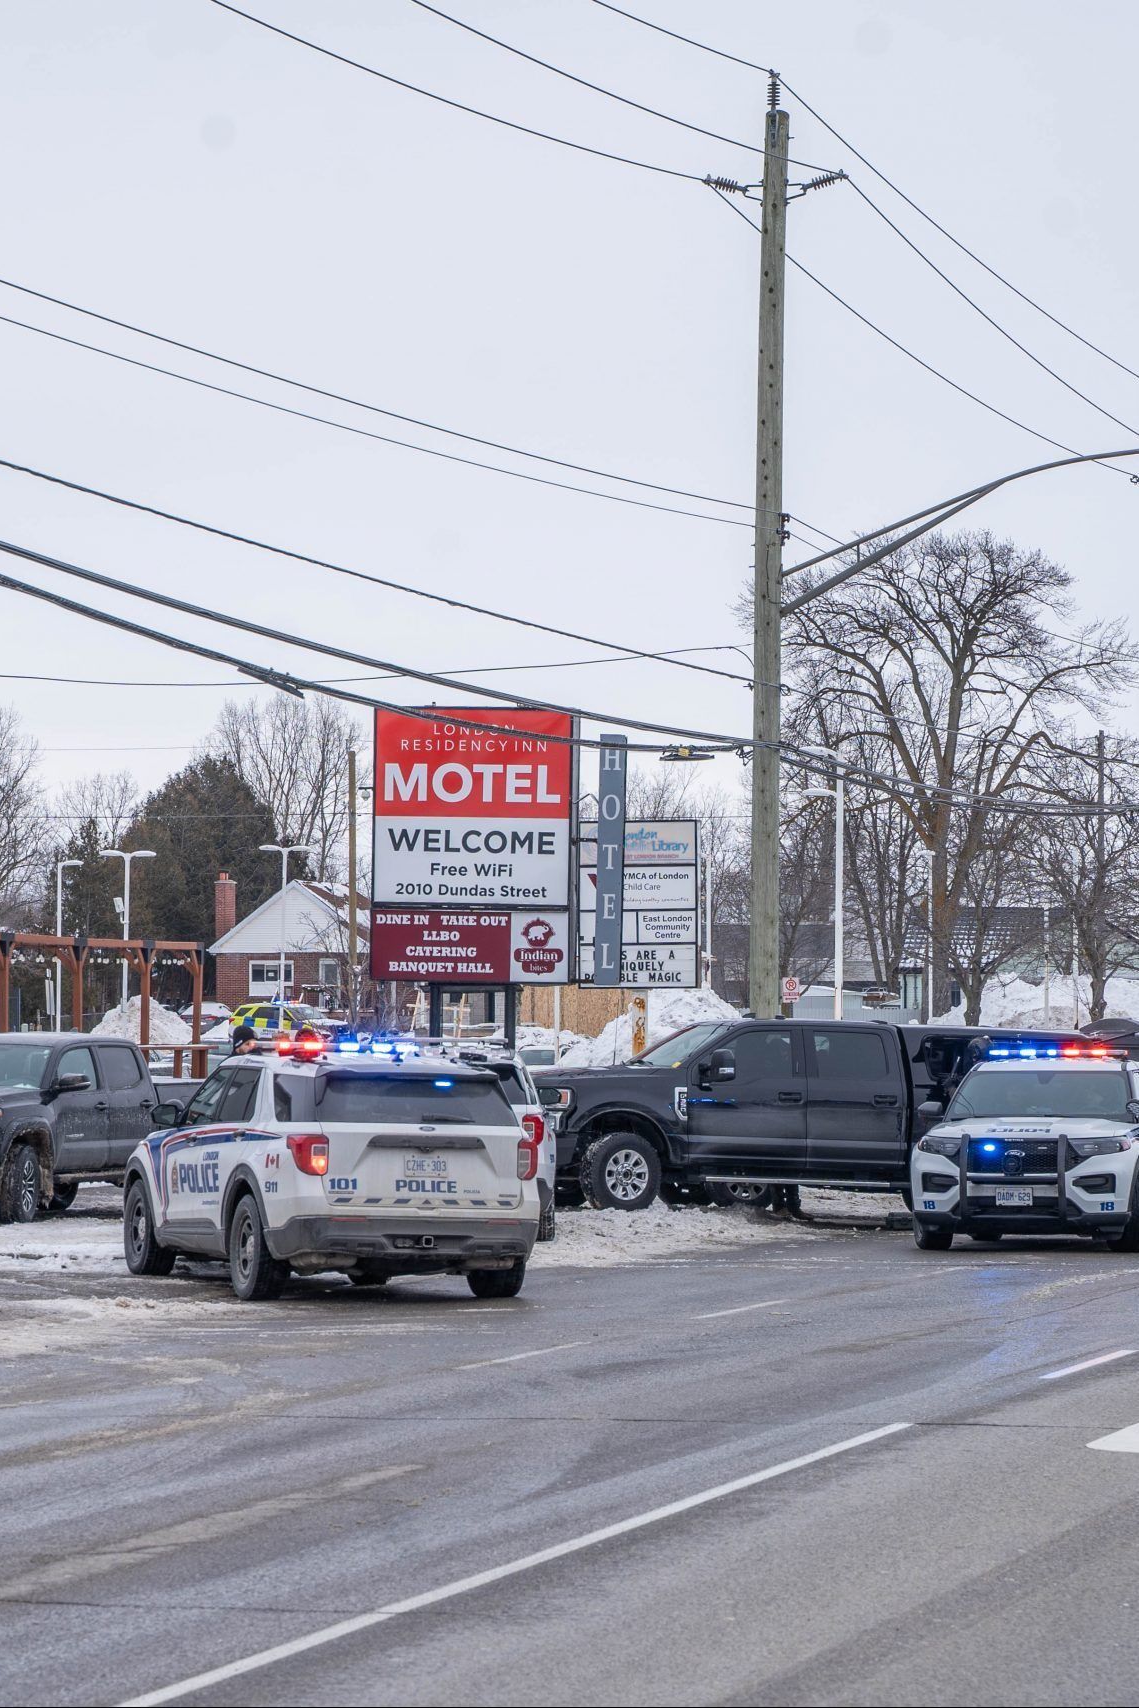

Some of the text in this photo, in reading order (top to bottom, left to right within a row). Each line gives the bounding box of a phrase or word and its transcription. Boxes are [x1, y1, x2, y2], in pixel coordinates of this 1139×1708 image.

[401, 739, 548, 752] RESIDENCY INN
[384, 762, 561, 803] MOTEL
[625, 827, 658, 840] ondon
[387, 828, 556, 855] WELCOME
[652, 840, 689, 853] Library
[602, 748, 621, 970] HOTEL
[430, 862, 513, 877] Free WiFi
[623, 871, 689, 880] YMCA of London
[395, 883, 548, 898] 2010 Dundas Street
[376, 914, 509, 926] DINE IN TAKE OUT
[422, 930, 460, 941] LLBO
[654, 931, 681, 939] Centre
[405, 946, 477, 957] CATERING
[519, 948, 558, 962] Indian
[636, 950, 657, 960] ARE
[668, 950, 675, 960] A
[388, 961, 494, 974] BANQUET HALL
[529, 963, 548, 972] bites
[648, 972, 681, 982] MAGIC
[179, 1162, 219, 1193] POLICE
[265, 1181, 278, 1192] 911
[328, 1178, 358, 1190] 101
[395, 1180, 458, 1193] POLICE
[922, 1200, 936, 1210] 18
[1099, 1202, 1115, 1211] 18
